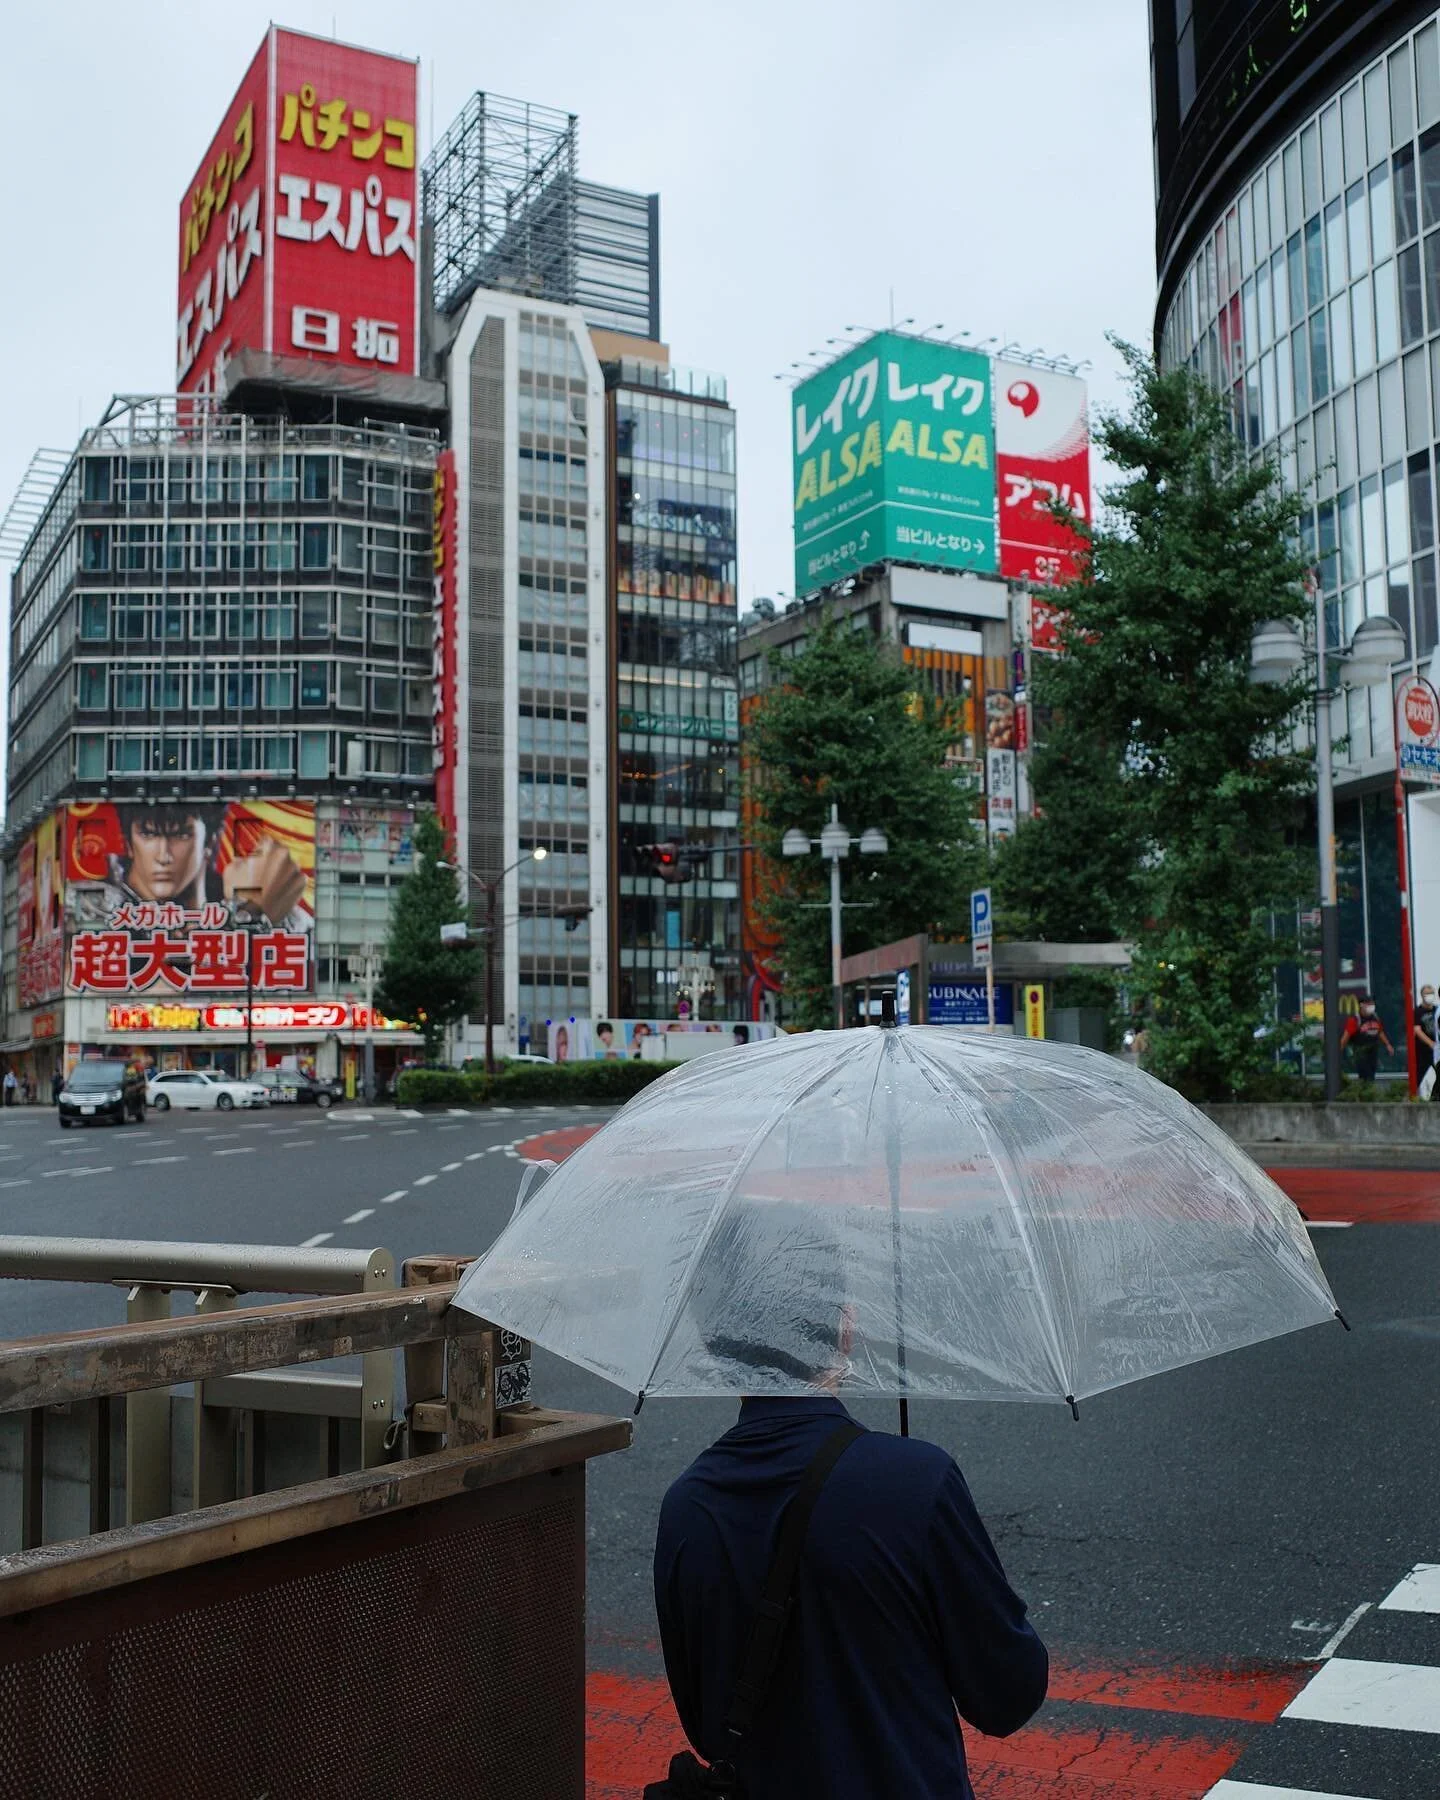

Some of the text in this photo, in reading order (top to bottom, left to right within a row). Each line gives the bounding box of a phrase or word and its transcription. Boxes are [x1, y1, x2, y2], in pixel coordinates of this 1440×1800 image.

[280, 82, 415, 169] パチンコ
[183, 102, 255, 273] パチンコ
[276, 173, 415, 263] エスパス
[177, 184, 263, 388] エスパス
[291, 304, 399, 365] 日拓
[796, 357, 879, 455] レイク
[887, 361, 985, 416] レイク
[795, 420, 883, 510] ALSA
[886, 418, 989, 470] ALSA
[896, 525, 972, 553] 当ビルとなり
[111, 902, 230, 930] メガホール
[973, 893, 989, 934] P
[72, 931, 309, 992] 超大型店
